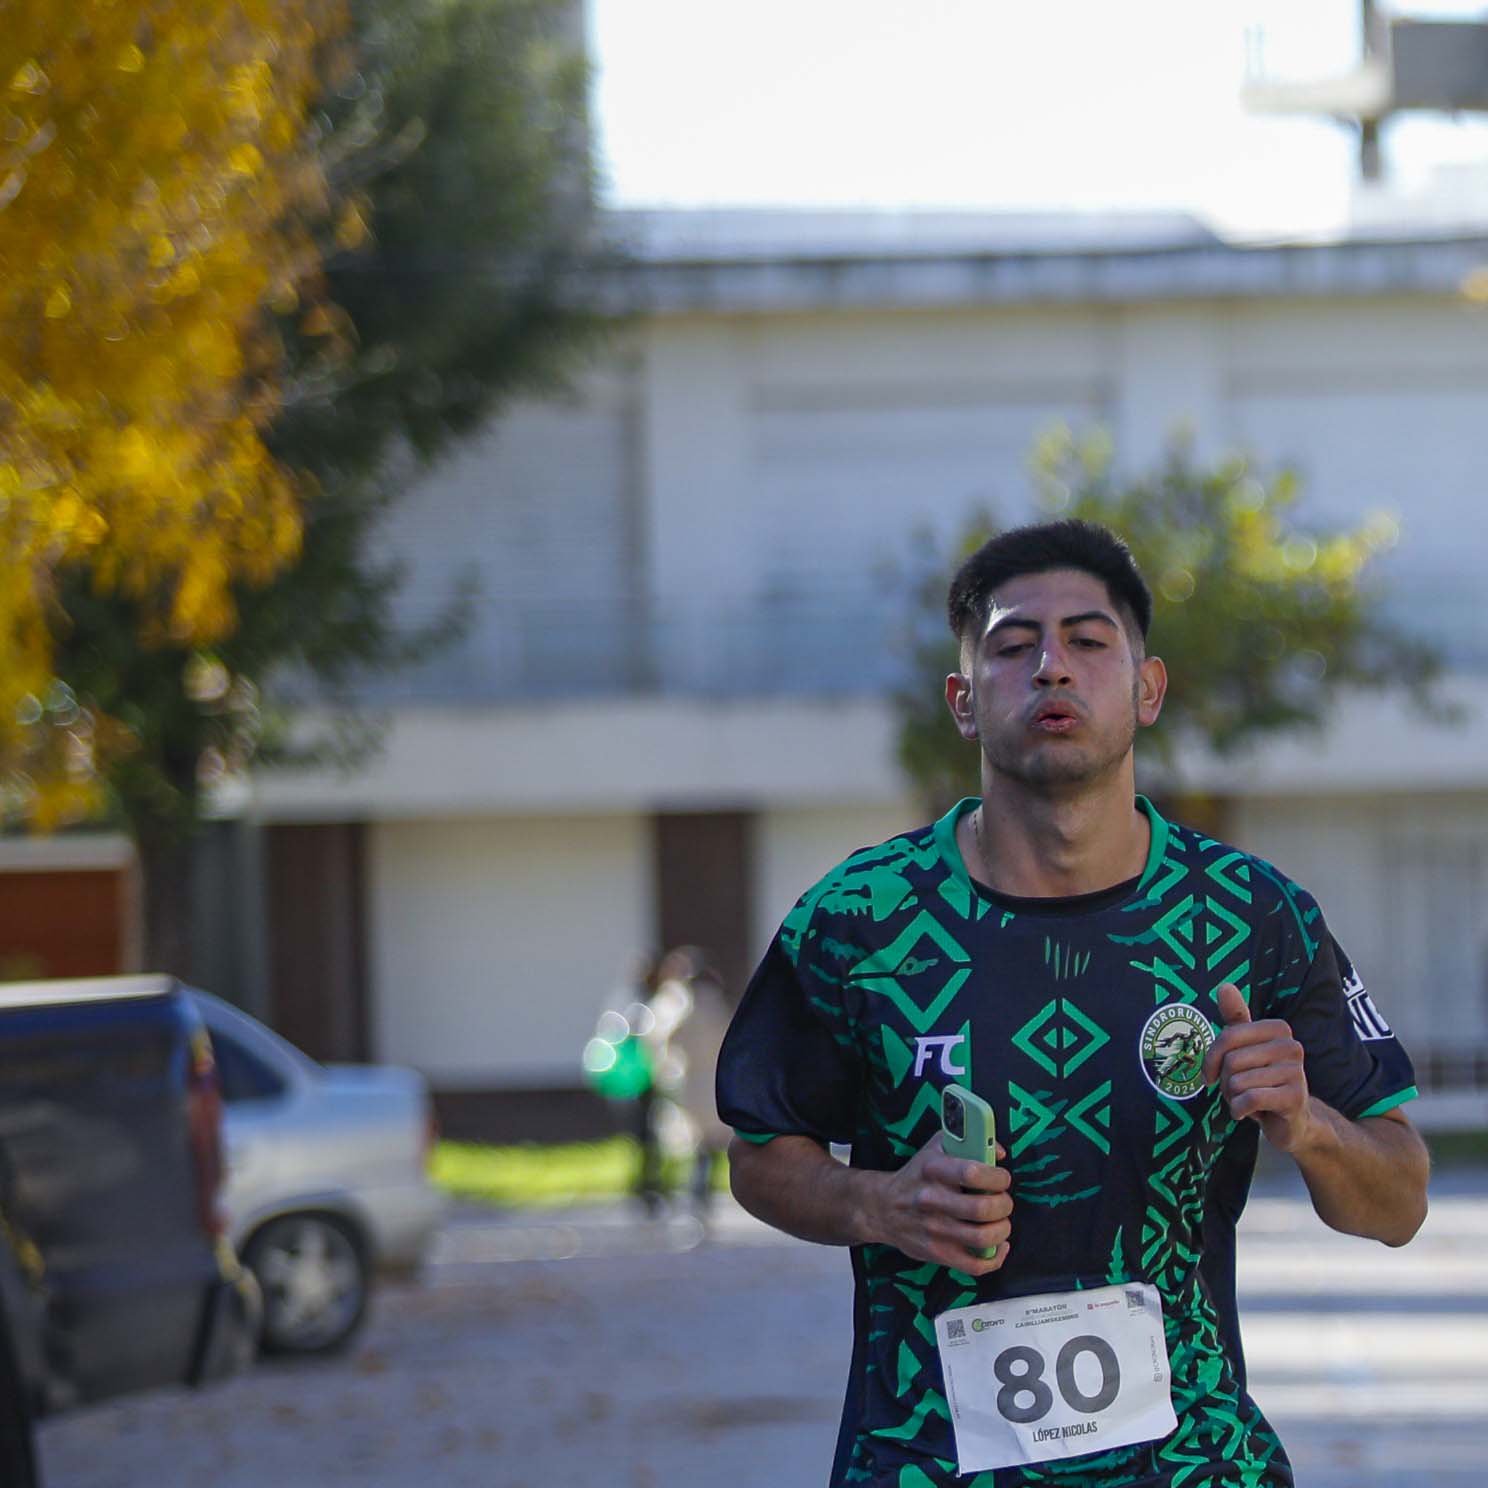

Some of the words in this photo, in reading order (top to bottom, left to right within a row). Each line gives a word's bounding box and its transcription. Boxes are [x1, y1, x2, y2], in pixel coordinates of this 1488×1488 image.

[1143, 1007, 1212, 1052] SINDRORUNNIN
[913, 1034, 966, 1077] FC
[1165, 1082, 1196, 1095] 2024
[993, 1335, 1121, 1424] 80
[1032, 1427, 1061, 1442] LÓPEZ
[1061, 1421, 1098, 1439] NICOLAS
